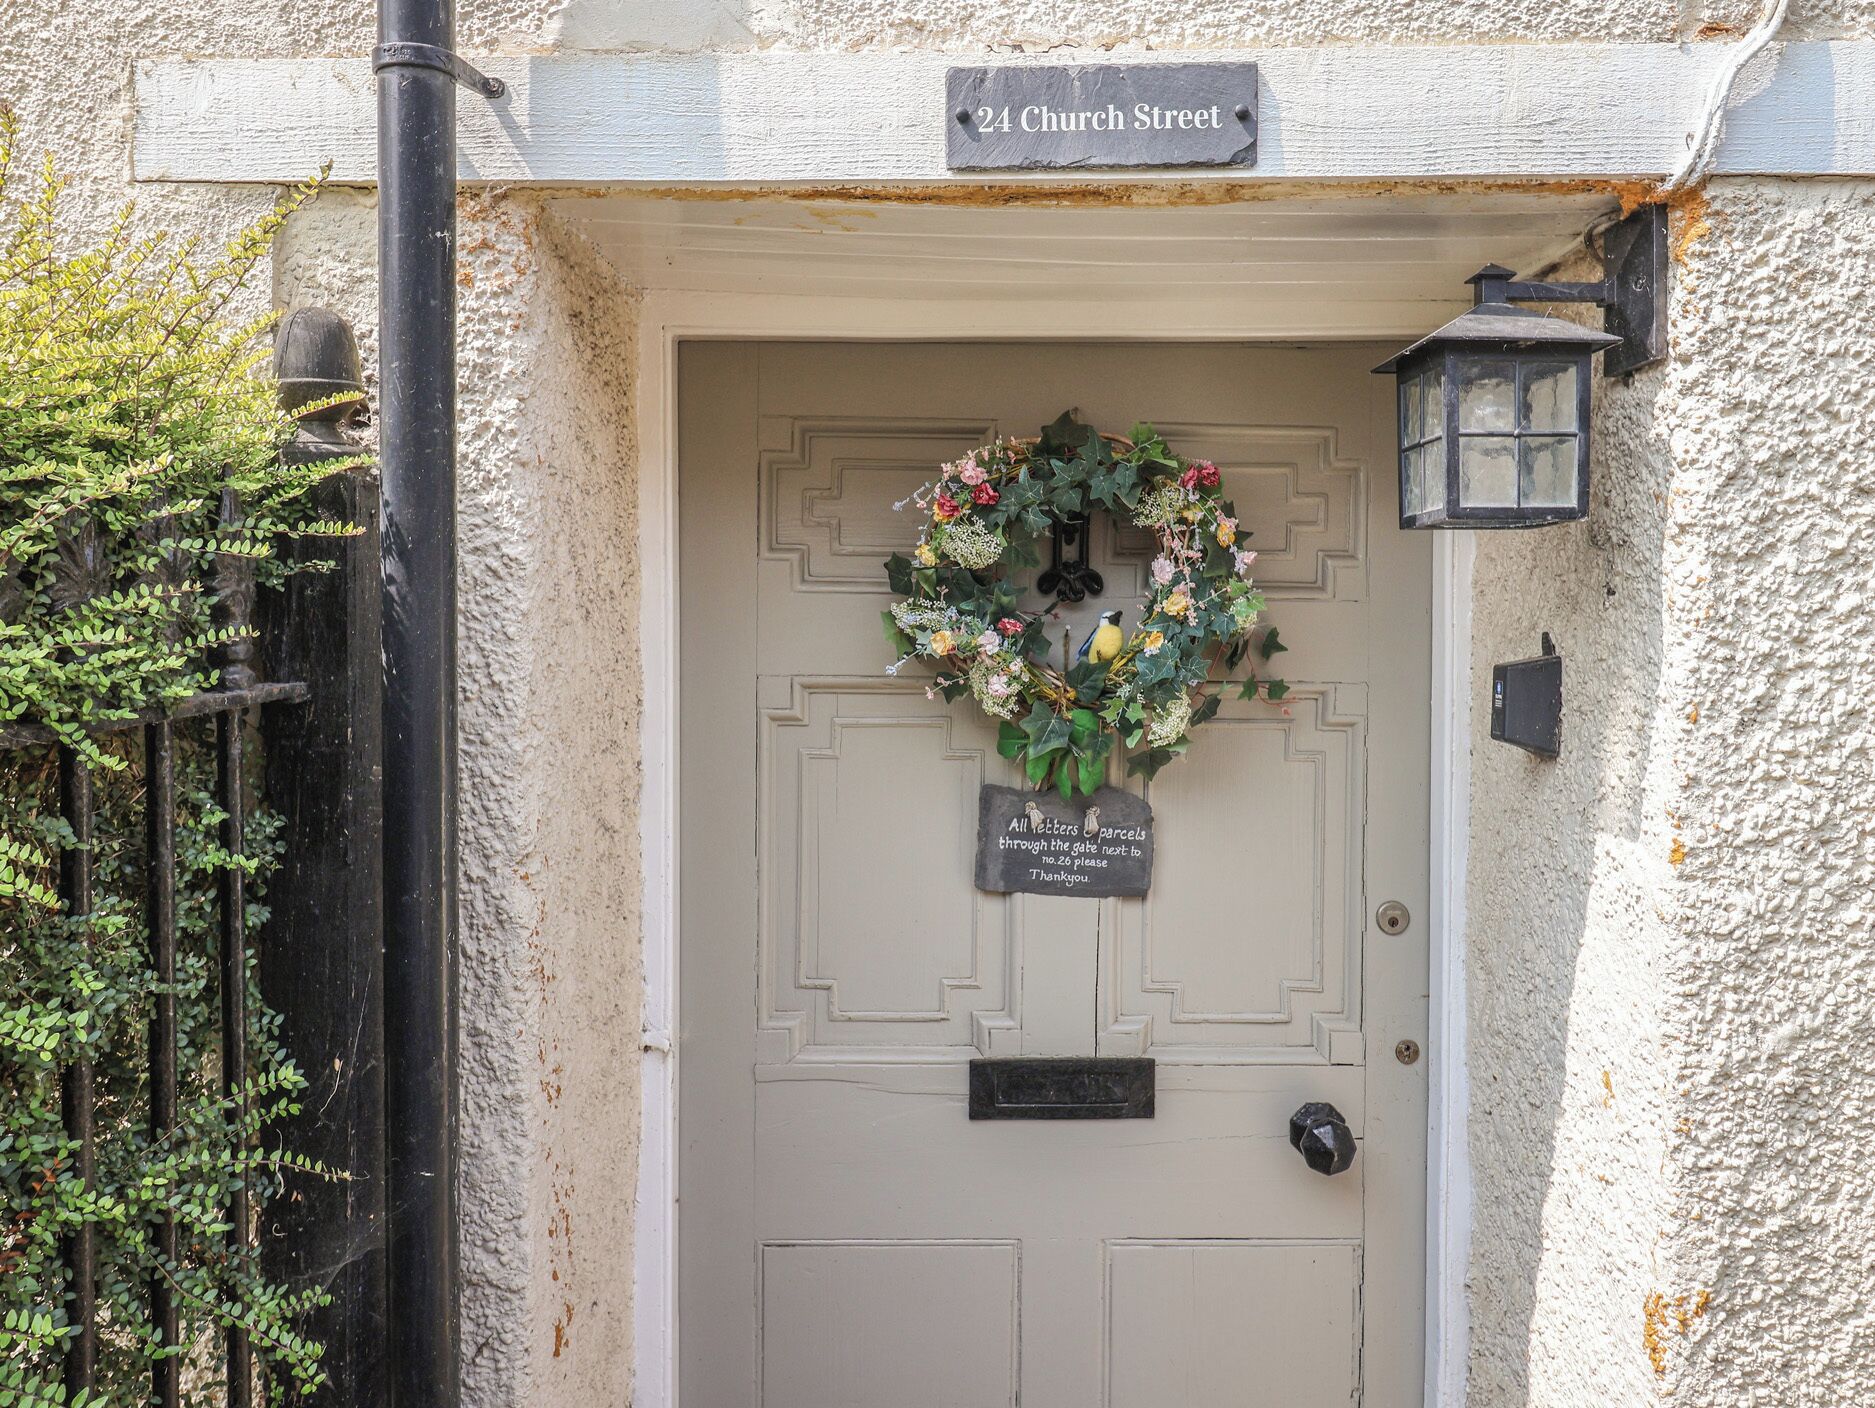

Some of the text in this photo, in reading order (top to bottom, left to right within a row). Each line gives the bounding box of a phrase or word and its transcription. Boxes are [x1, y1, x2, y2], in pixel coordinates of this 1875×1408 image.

[977, 103, 1223, 133] 24 Church Street
[1008, 817, 1028, 833] All
[1032, 818, 1079, 837] etters
[1098, 826, 1147, 844] parcels
[998, 836, 1142, 857] through the gate next to
[1073, 856, 1108, 871] please
